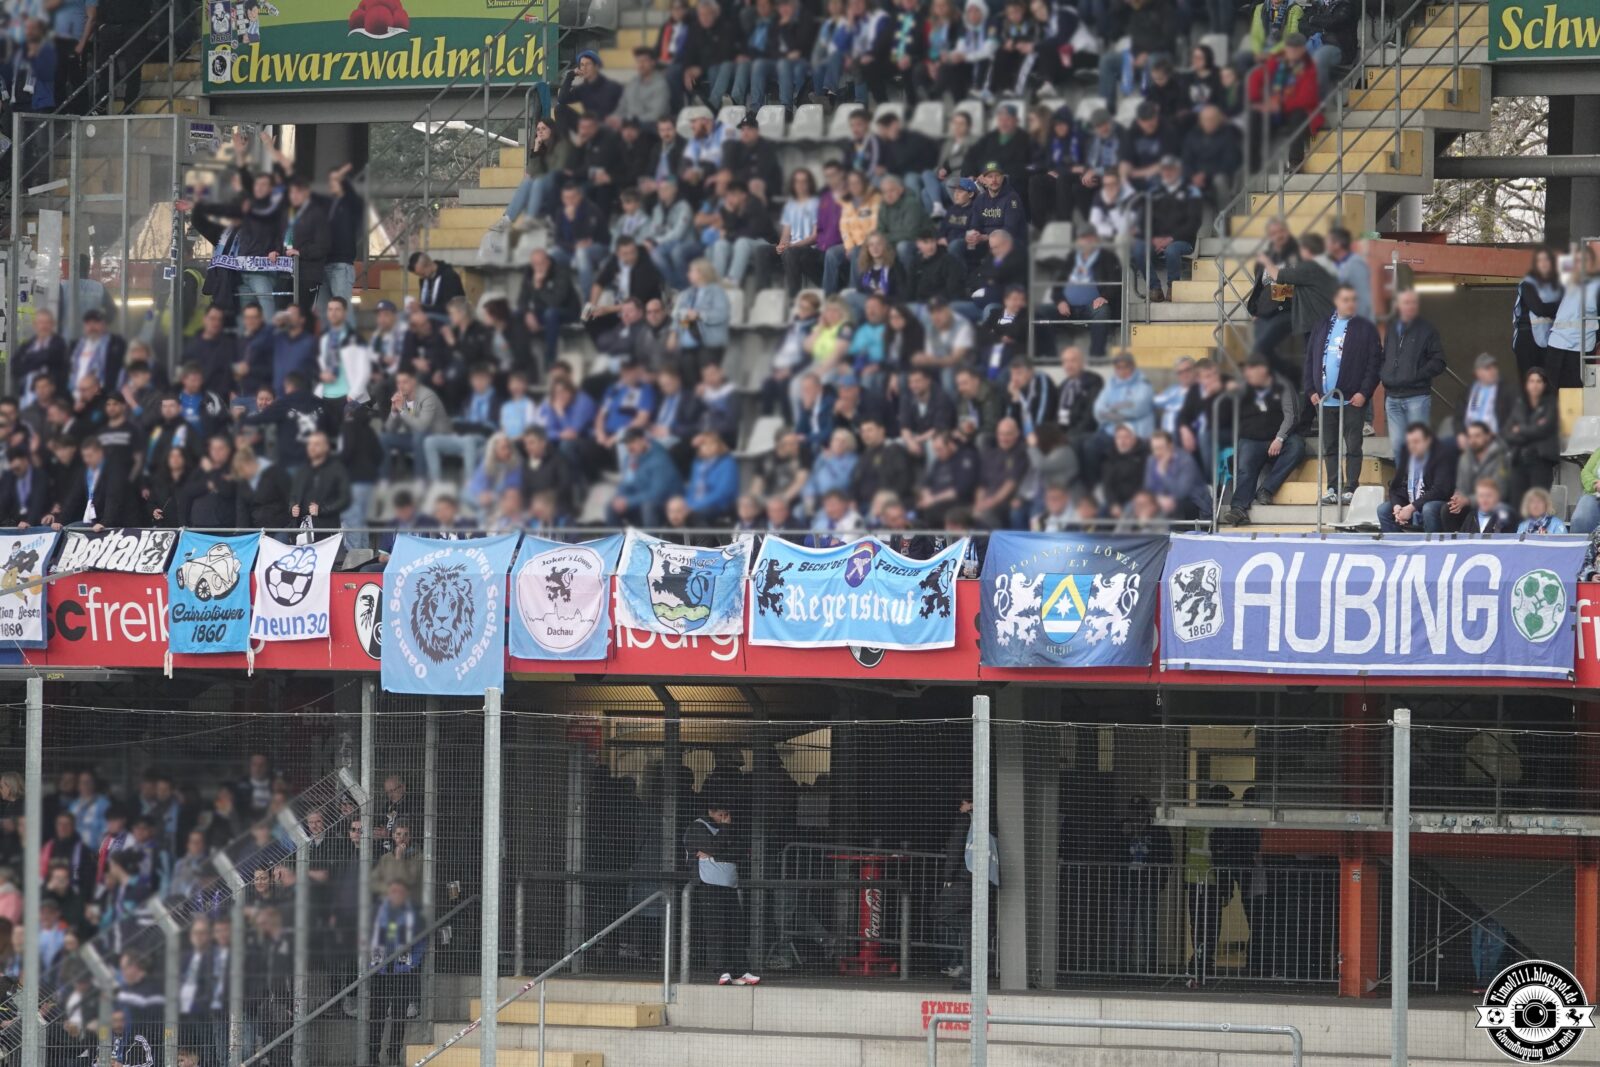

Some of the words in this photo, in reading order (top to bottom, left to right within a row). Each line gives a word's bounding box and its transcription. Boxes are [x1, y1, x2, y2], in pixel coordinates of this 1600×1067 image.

[1232, 550, 1503, 656] AUBING
[191, 624, 227, 643] 1860
[253, 612, 328, 636] neun30
[546, 626, 574, 636] Dachau
[1188, 622, 1213, 638] 1860
